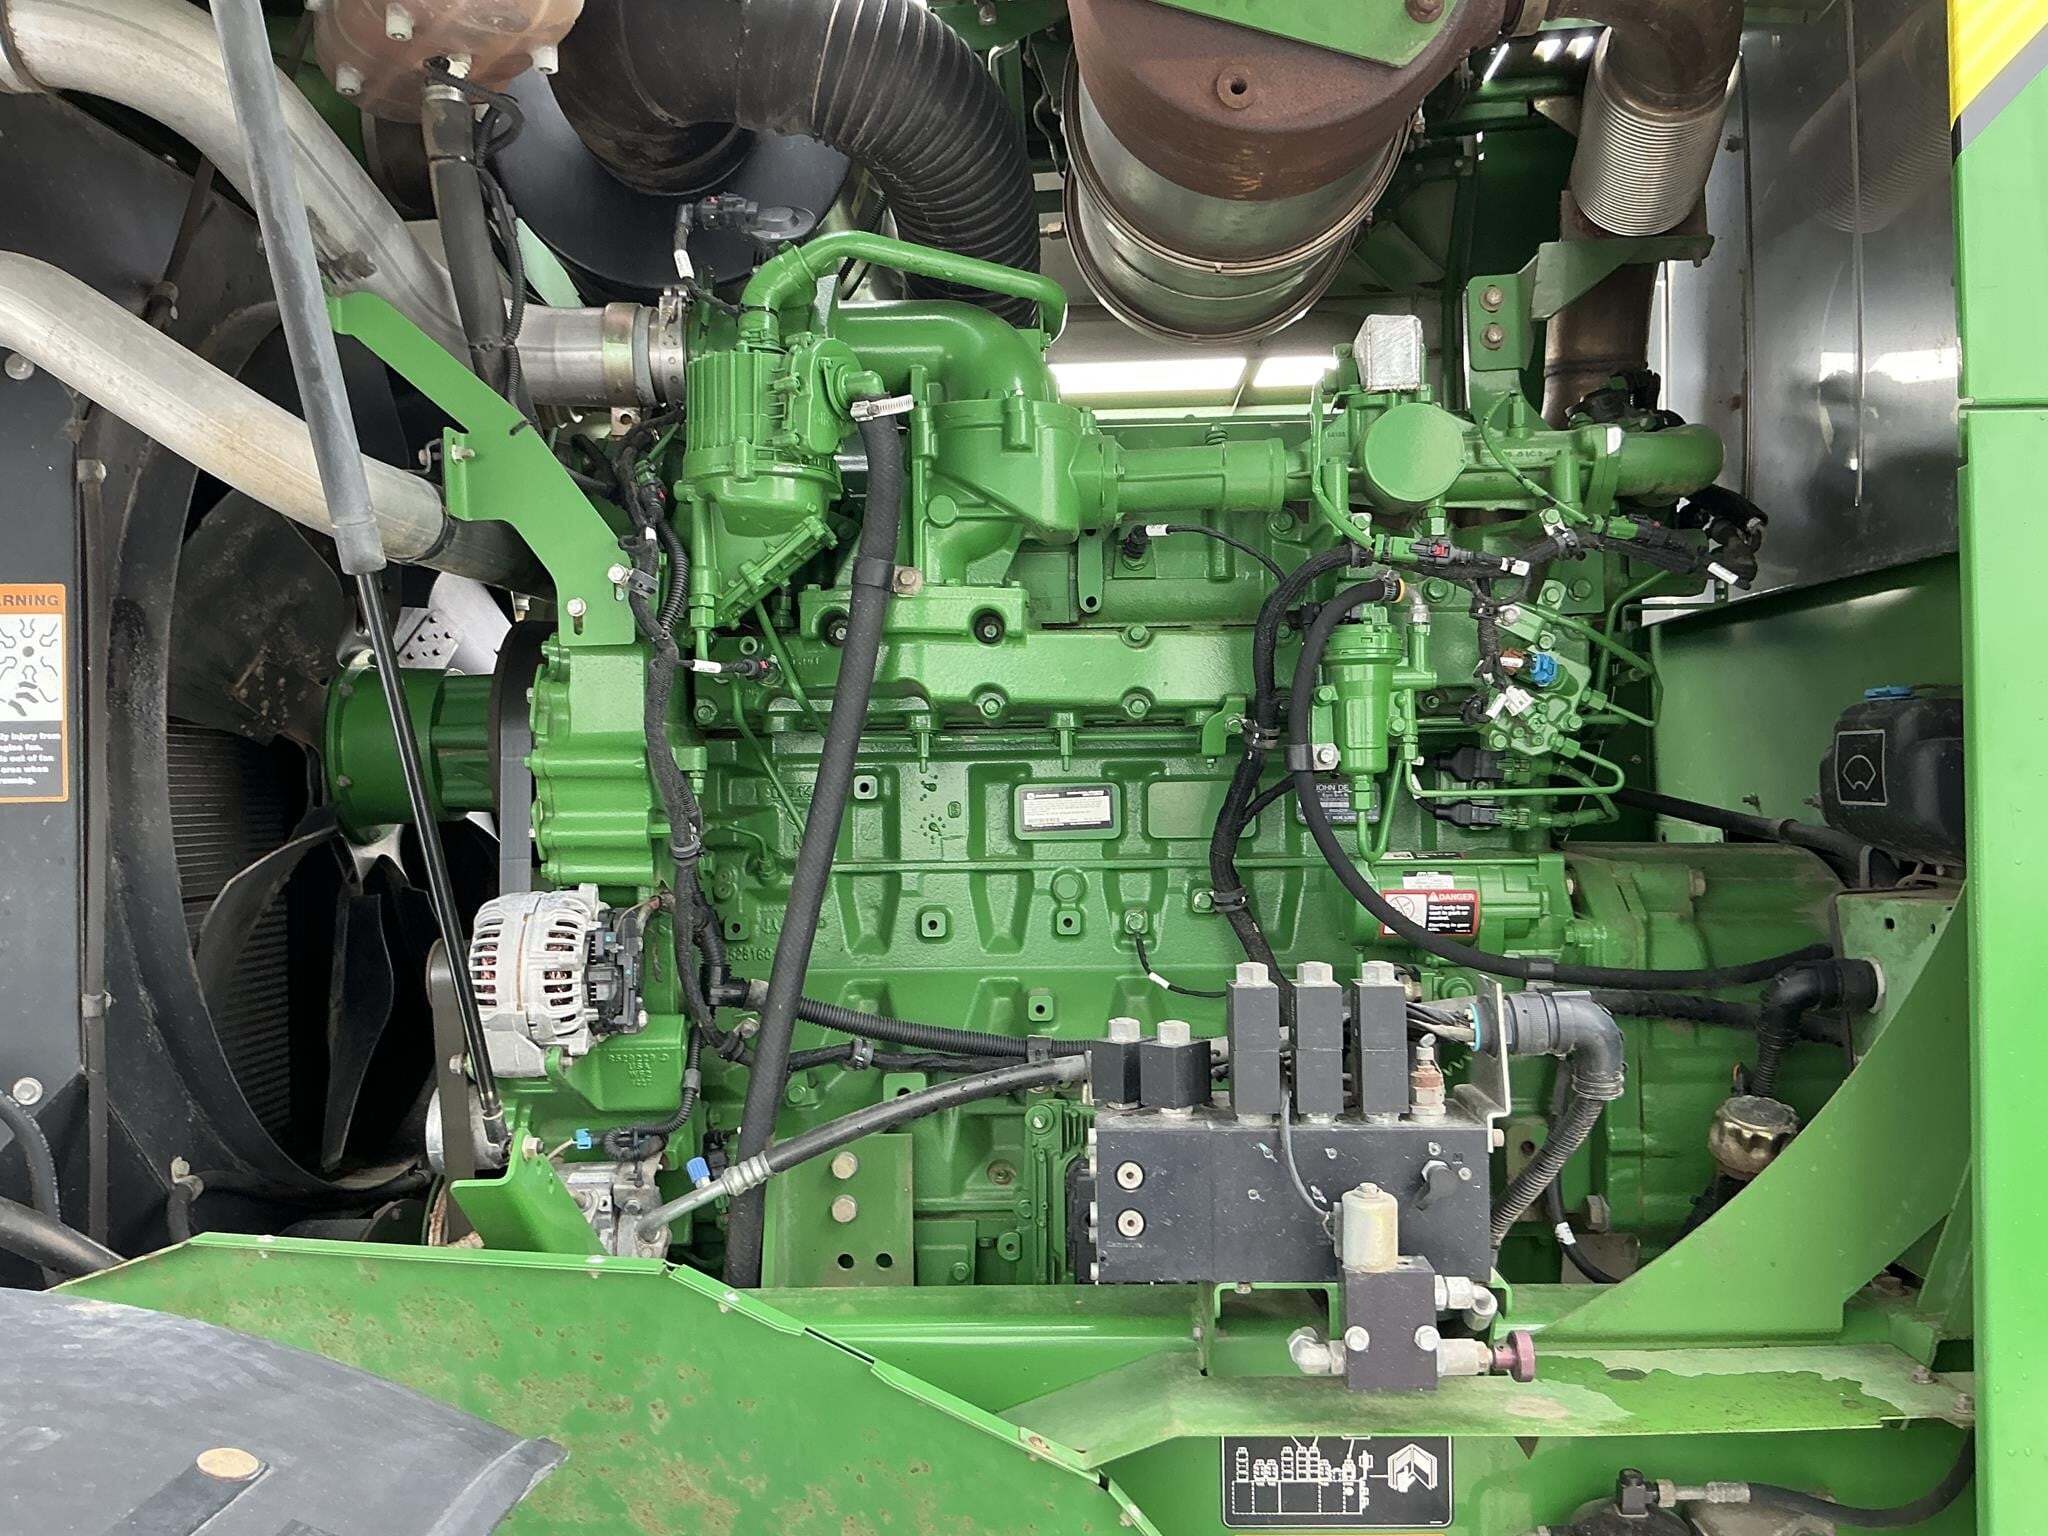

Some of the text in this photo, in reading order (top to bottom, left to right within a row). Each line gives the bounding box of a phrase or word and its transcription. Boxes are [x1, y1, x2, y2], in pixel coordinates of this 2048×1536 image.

[0, 594, 59, 606] RNING
[11, 732, 37, 741] injury
[39, 732, 61, 740] from
[23, 765, 49, 773] when
[1439, 893, 1475, 901] DANGER
